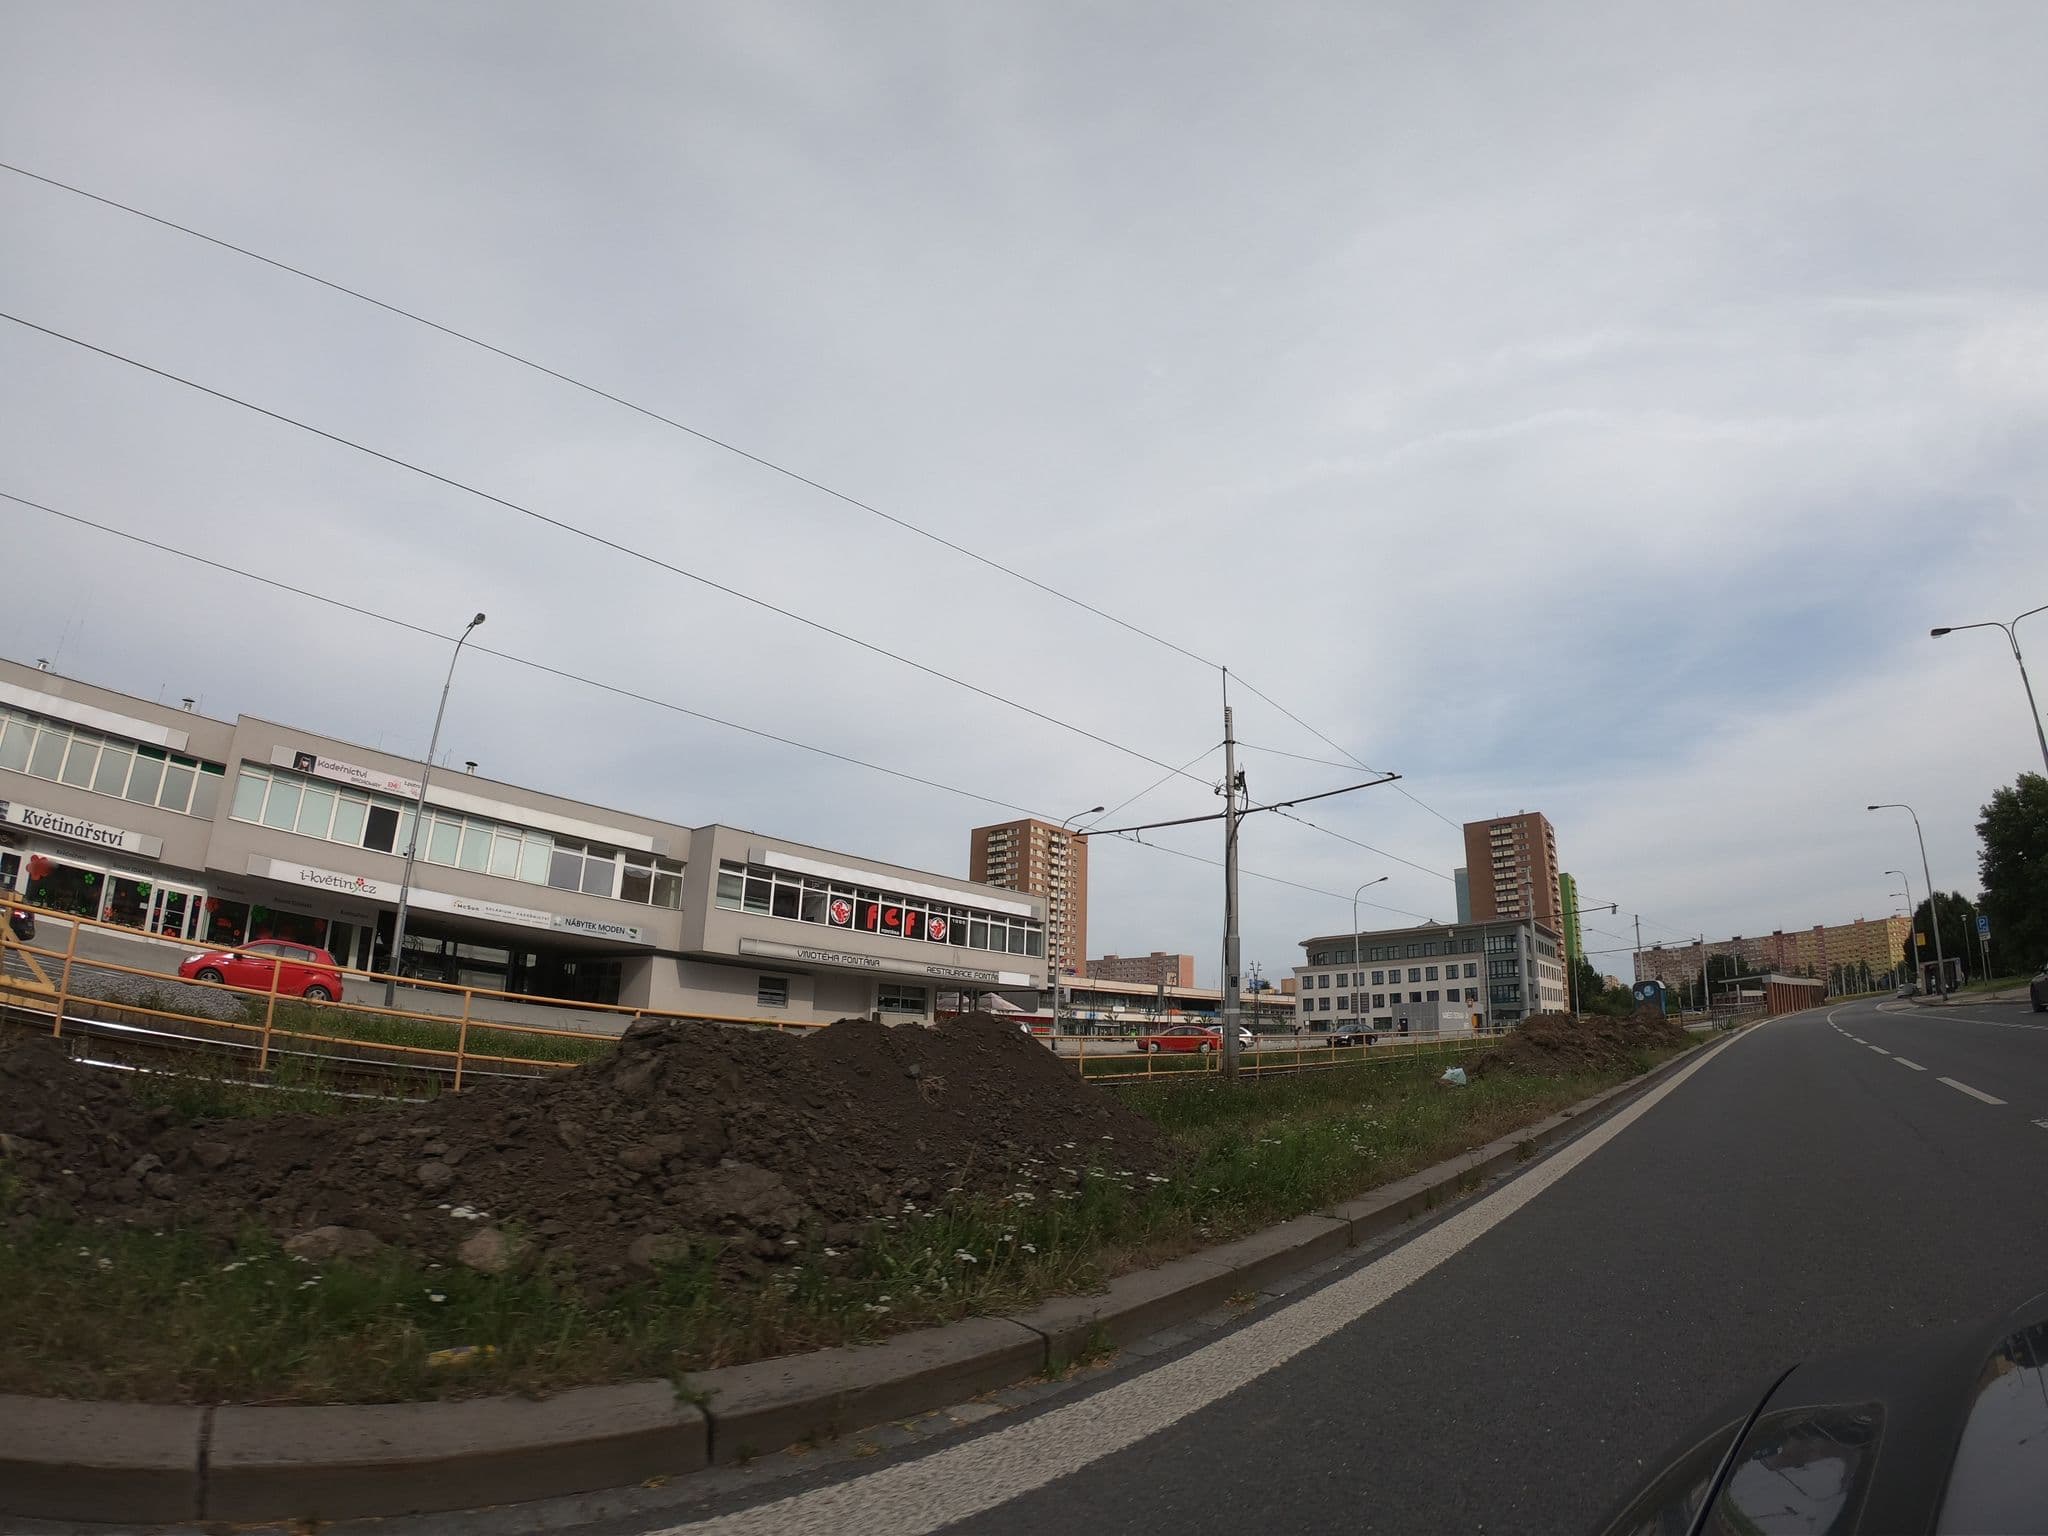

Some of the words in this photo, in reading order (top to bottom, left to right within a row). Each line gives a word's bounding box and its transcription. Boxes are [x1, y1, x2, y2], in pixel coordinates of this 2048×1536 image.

[22, 808, 126, 846] Květinářství
[300, 869, 377, 894] i-květiny.cz
[565, 917, 597, 930] NÁBYTEK
[597, 923, 626, 935] MODEN
[926, 966, 973, 978] RESTAURACE
